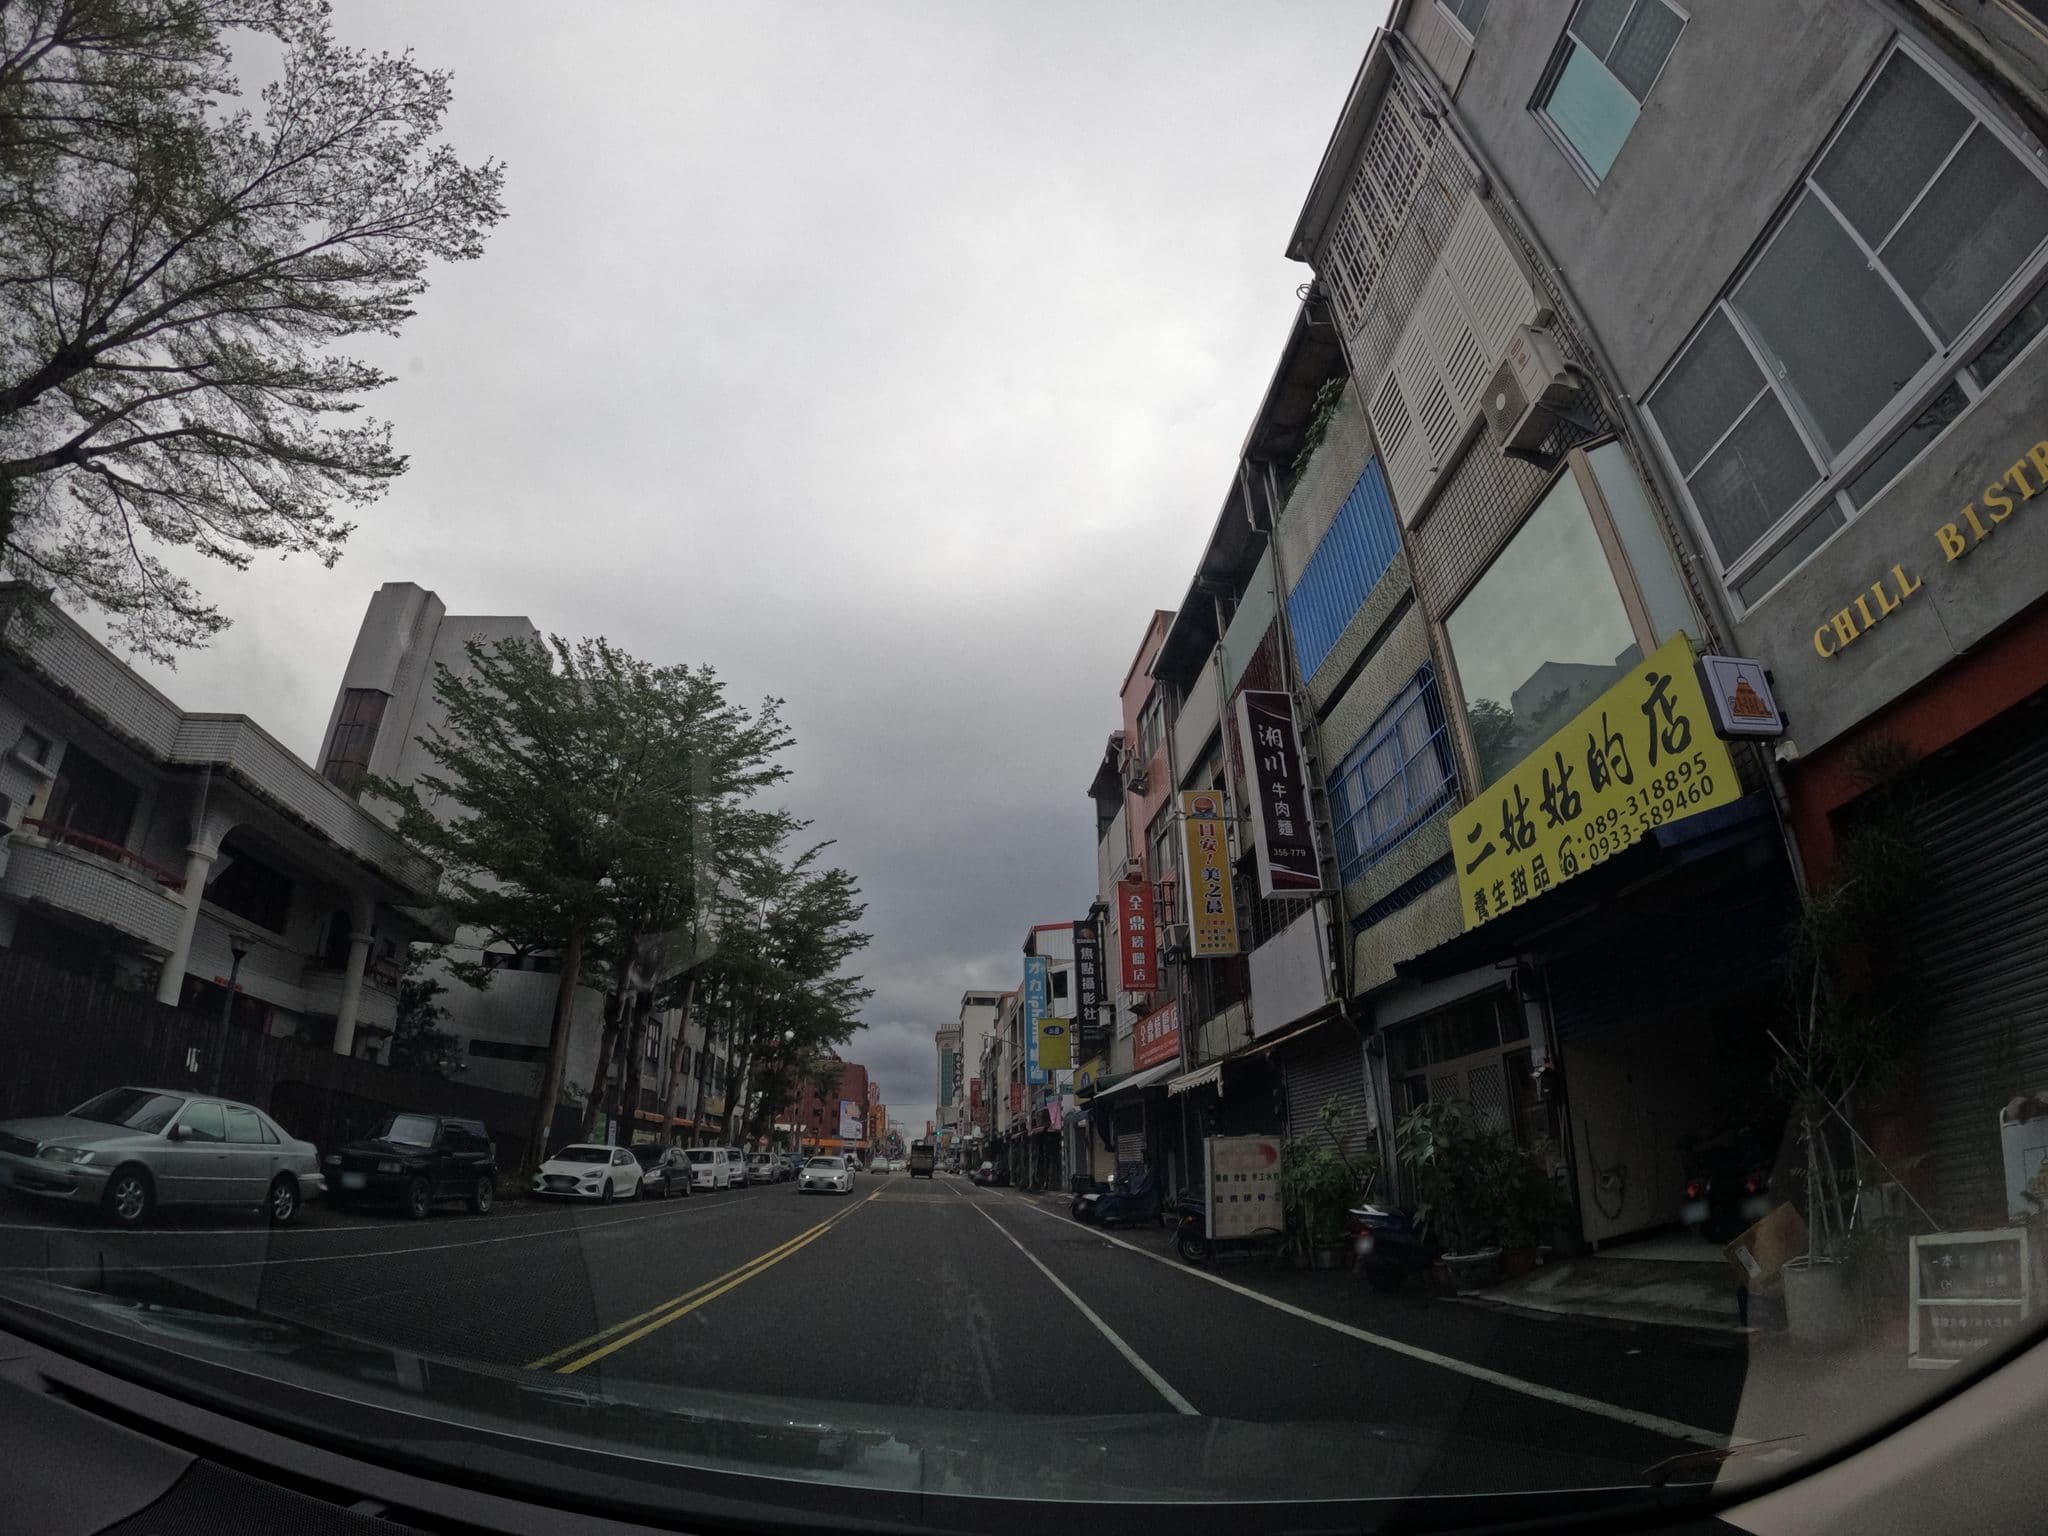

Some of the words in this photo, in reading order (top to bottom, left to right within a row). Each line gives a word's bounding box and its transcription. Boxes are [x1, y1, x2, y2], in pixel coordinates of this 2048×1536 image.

[1814, 563, 1922, 658] CHILL
[1258, 723, 1295, 837] 湘川牛肉麵
[1466, 671, 1692, 875] 二姑姑的店
[1584, 751, 1708, 841] 089-318895
[1589, 774, 1715, 861] 0933-589460
[1473, 853, 1551, 922] 養生甜品
